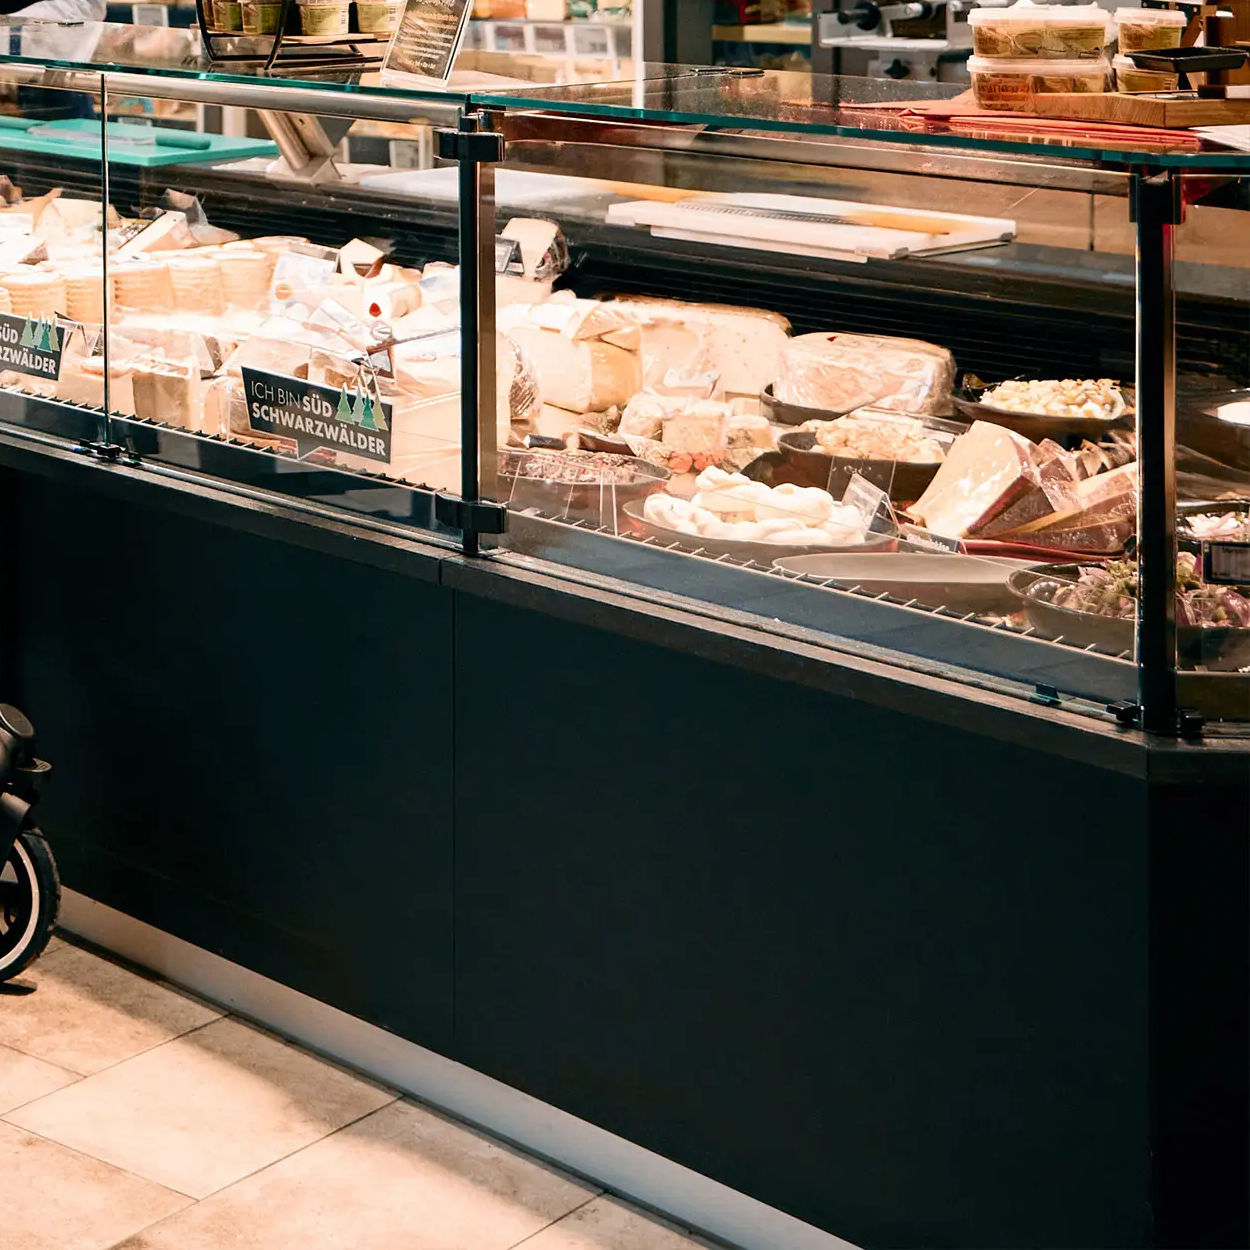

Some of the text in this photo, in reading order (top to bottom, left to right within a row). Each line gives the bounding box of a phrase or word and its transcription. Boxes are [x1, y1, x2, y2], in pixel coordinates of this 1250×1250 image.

[251, 381, 332, 418] ICH BIN SÜD
[252, 402, 386, 456] SCHWARZWÄLDER
